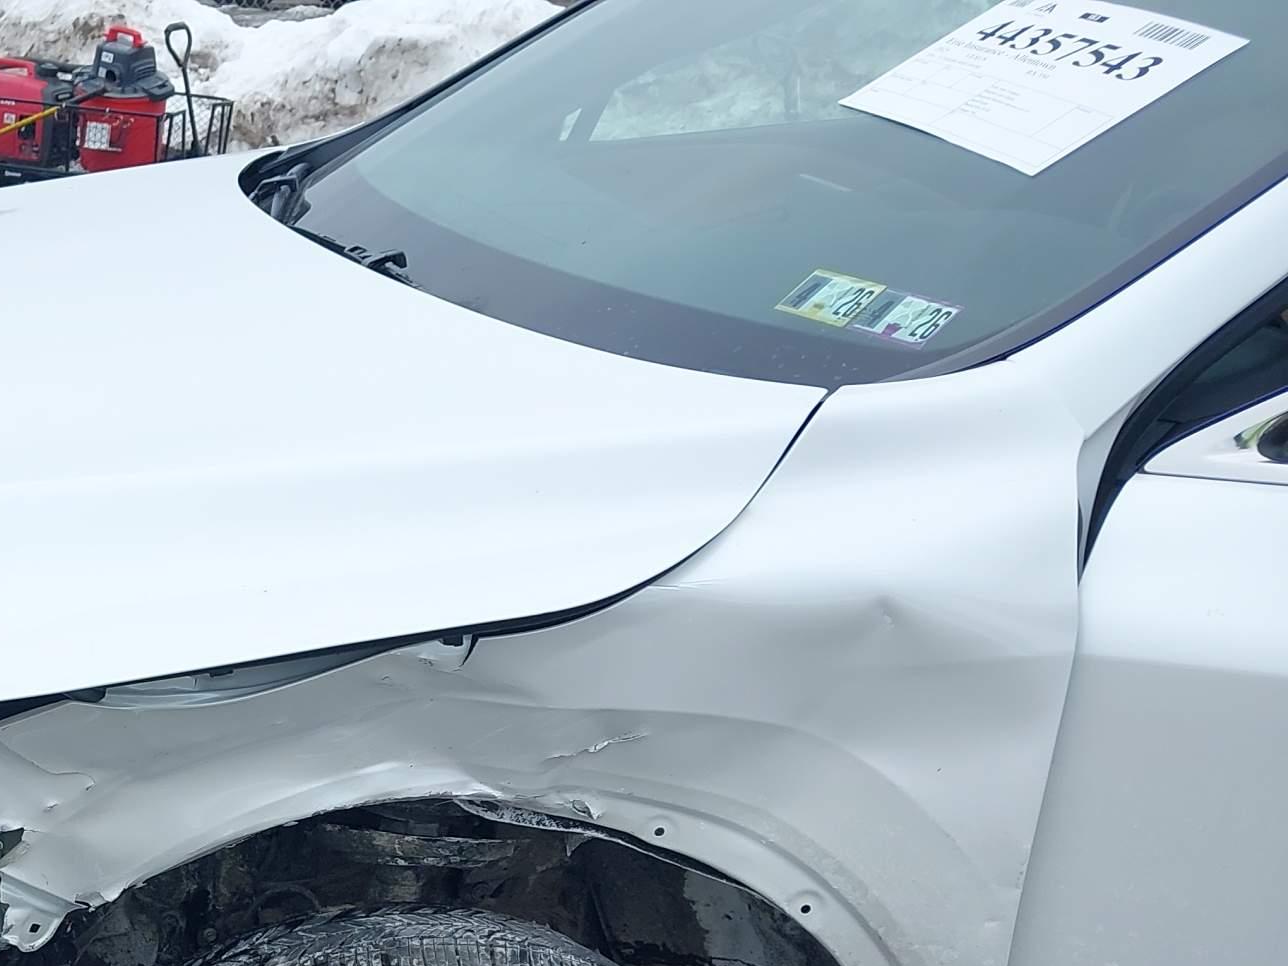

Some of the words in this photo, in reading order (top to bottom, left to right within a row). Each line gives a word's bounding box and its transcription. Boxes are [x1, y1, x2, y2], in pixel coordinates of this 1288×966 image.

[975, 20, 1164, 82] 44357543
[832, 287, 875, 319] 26
[908, 307, 953, 340] 26
